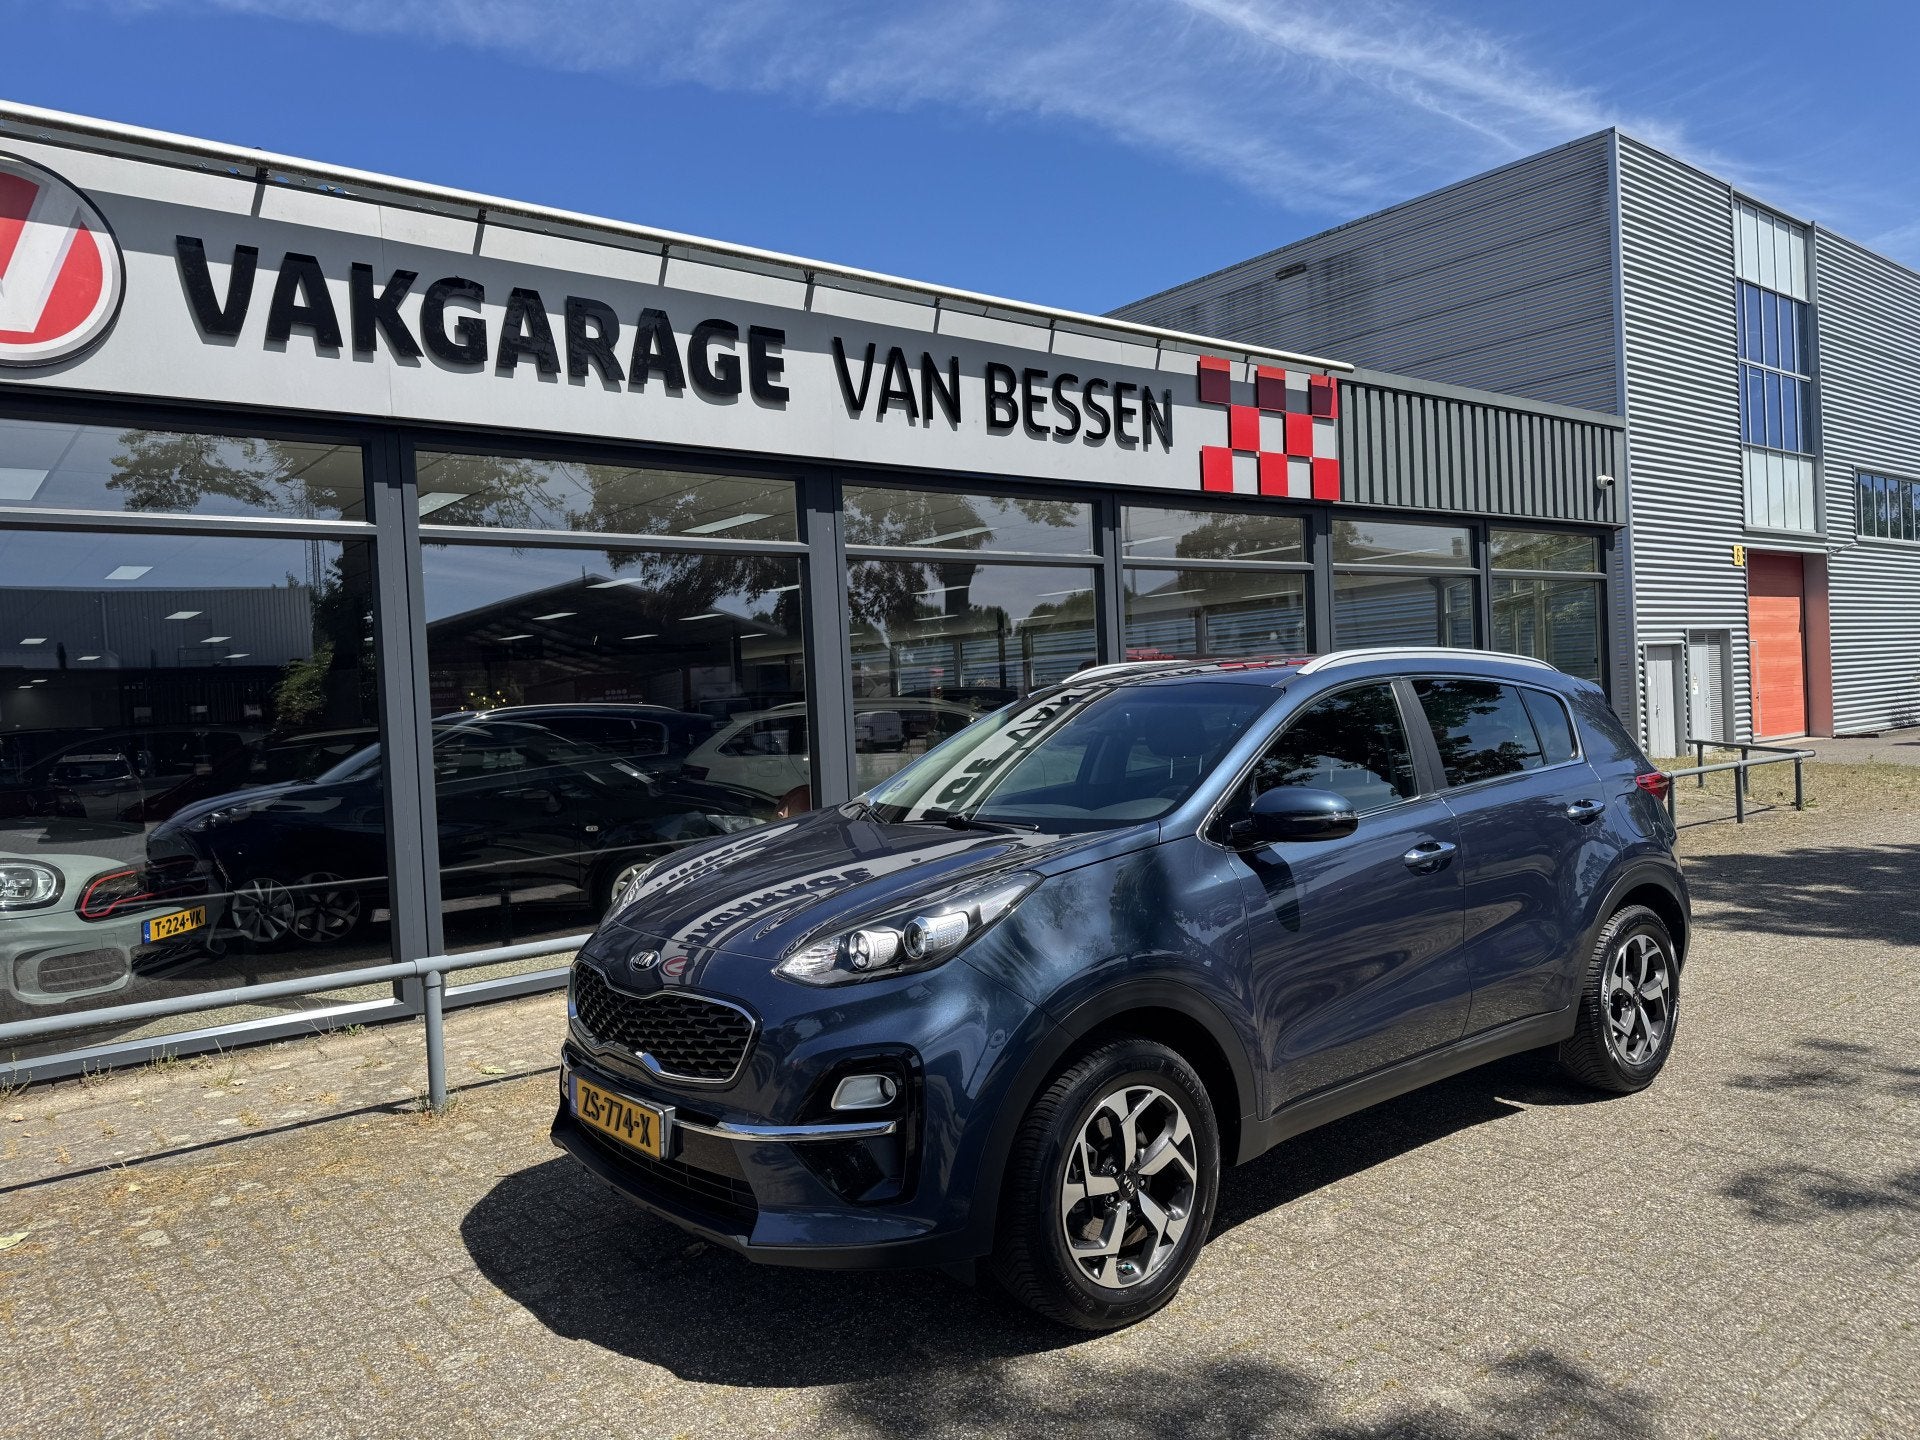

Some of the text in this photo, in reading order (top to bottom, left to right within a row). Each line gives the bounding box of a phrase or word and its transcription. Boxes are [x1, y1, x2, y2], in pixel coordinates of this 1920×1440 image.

[175, 234, 1174, 449] VAKGARAGE VAN BESSEN
[155, 910, 203, 938] T-224-VK
[582, 1086, 651, 1148] ZS-774-X
